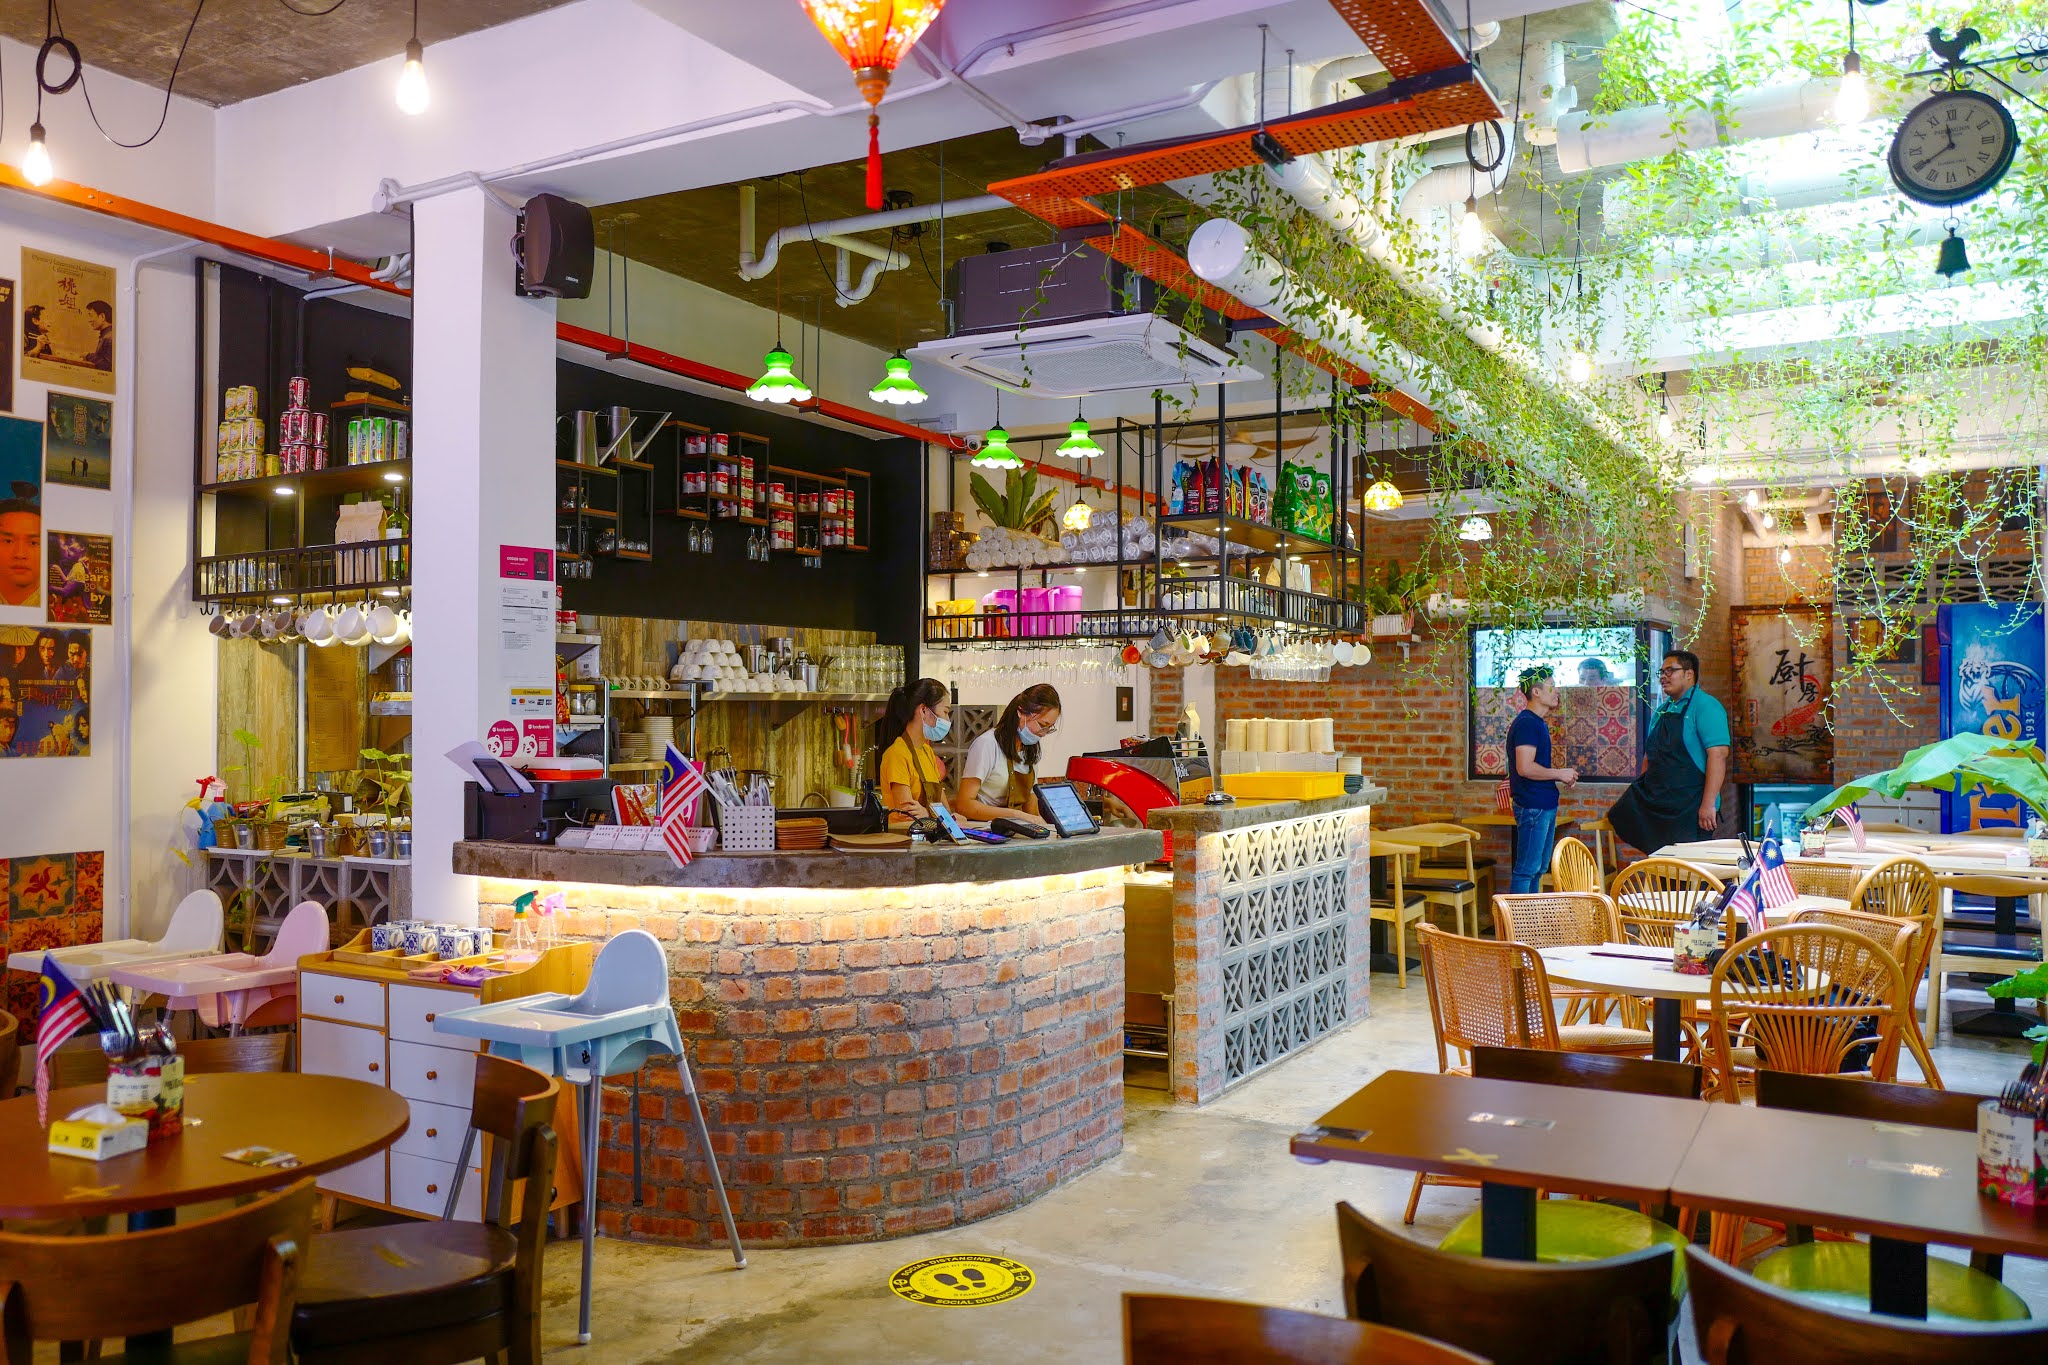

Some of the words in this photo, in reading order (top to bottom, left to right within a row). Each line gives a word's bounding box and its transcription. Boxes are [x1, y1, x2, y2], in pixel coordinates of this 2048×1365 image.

[90, 593, 105, 604] by
[2026, 711, 2035, 738] 1932
[901, 1263, 929, 1276] SOCIAL
[928, 1256, 991, 1264] DISTANCING
[975, 1286, 1023, 1304] DISTANCING
